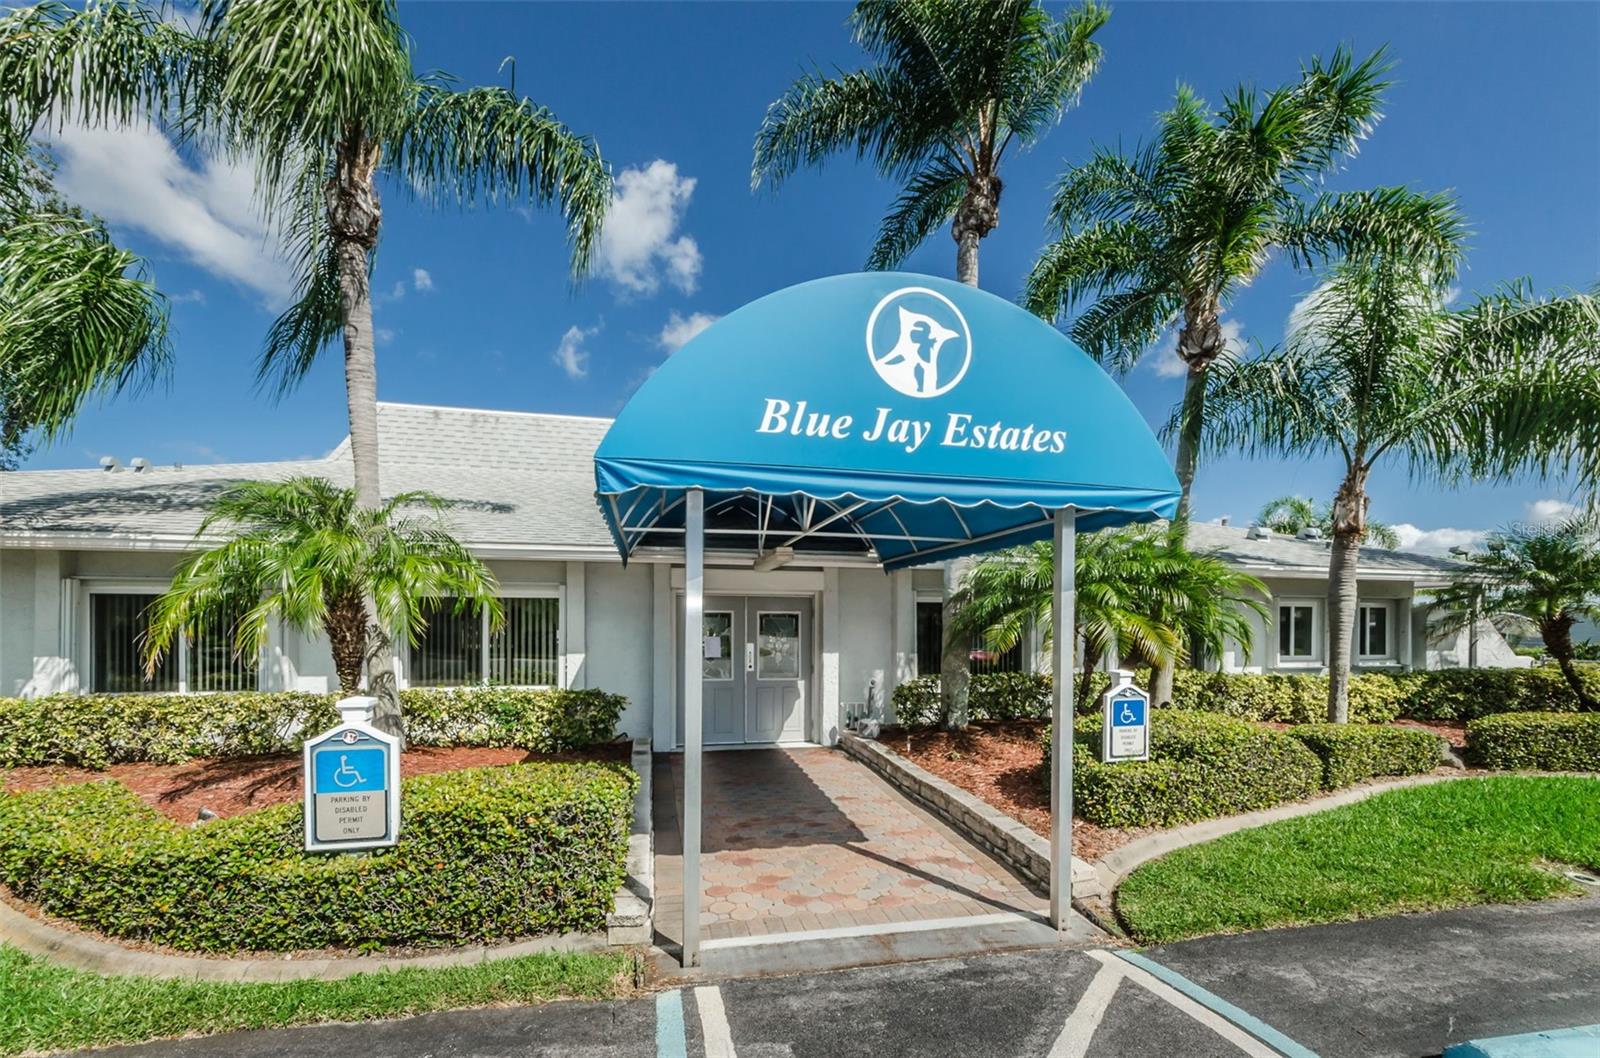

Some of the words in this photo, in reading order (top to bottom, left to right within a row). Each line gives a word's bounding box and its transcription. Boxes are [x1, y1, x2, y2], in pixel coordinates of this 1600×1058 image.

[756, 398, 853, 439] Blue
[863, 407, 931, 453] Jay
[940, 412, 1067, 454] Estates
[335, 806, 367, 814] DISABLED
